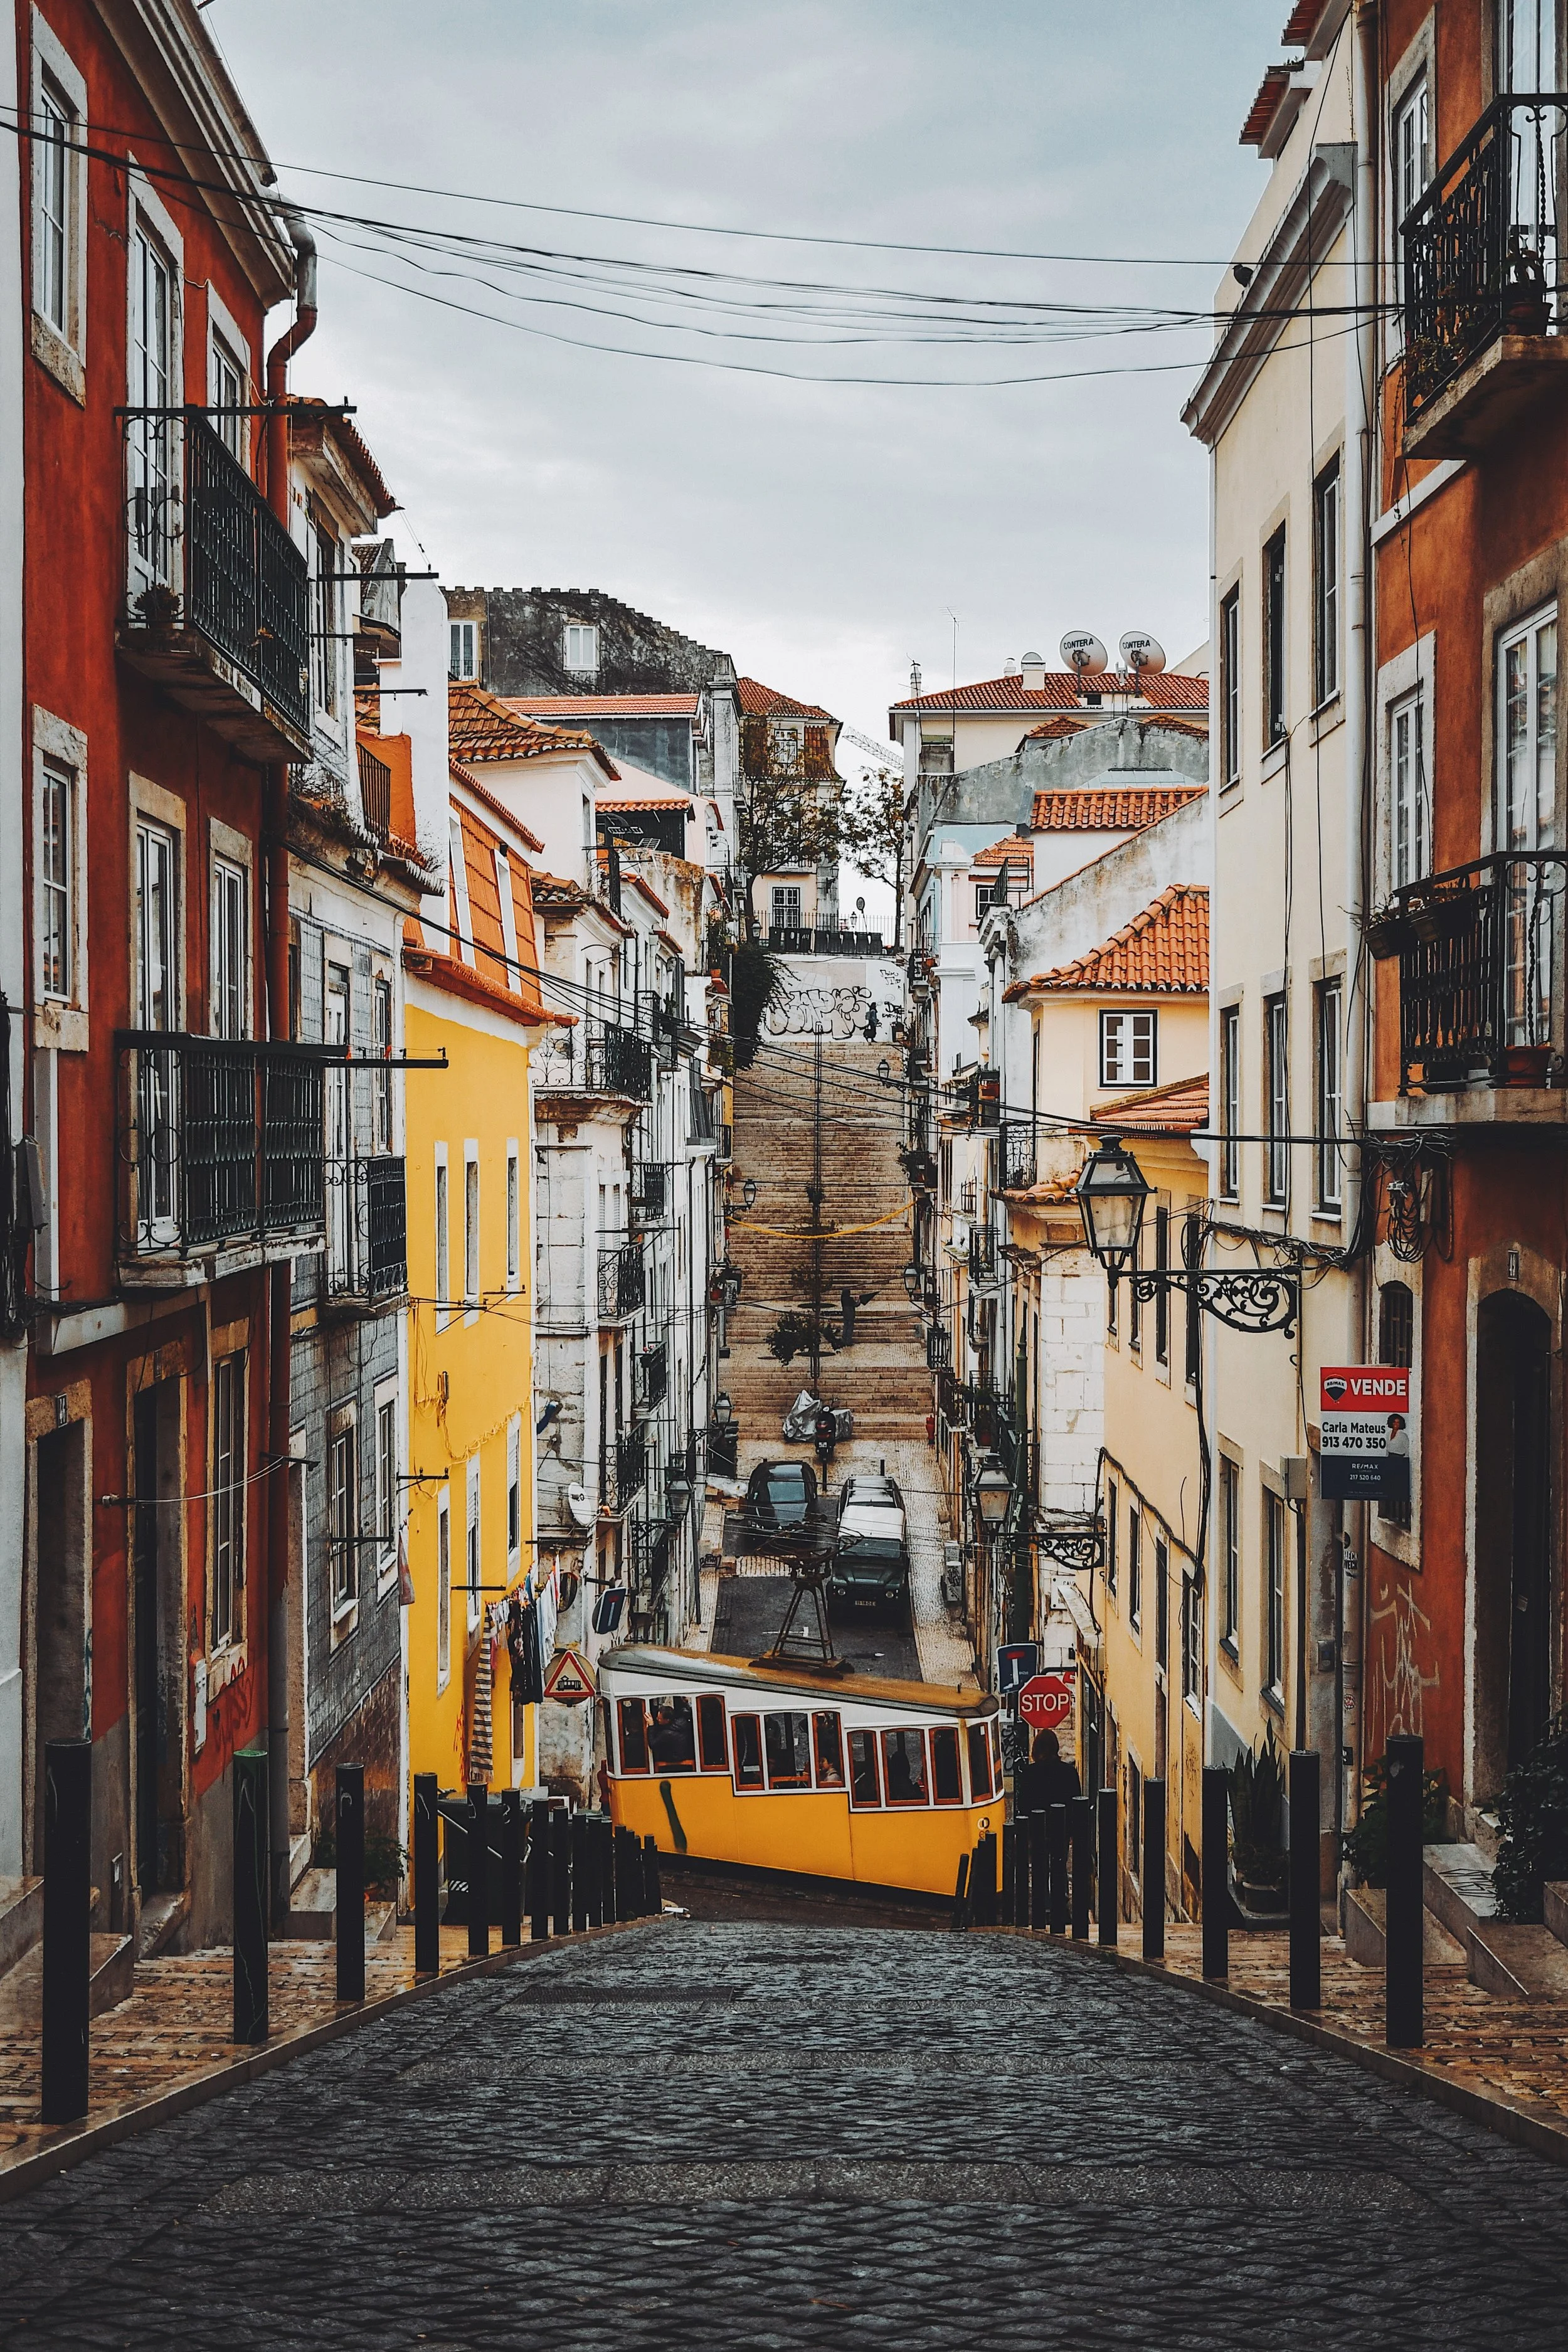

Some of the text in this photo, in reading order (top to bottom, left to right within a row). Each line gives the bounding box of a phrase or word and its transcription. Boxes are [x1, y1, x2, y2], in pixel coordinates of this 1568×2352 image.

[1063, 638, 1094, 650] CONTERA
[1122, 640, 1151, 650] CONTERA
[1350, 1379, 1406, 1396] VENDE
[1322, 1421, 1386, 1434] Carla Mateus
[1322, 1436, 1387, 1449] 913 470 350
[1021, 1693, 1069, 1712] STOP
